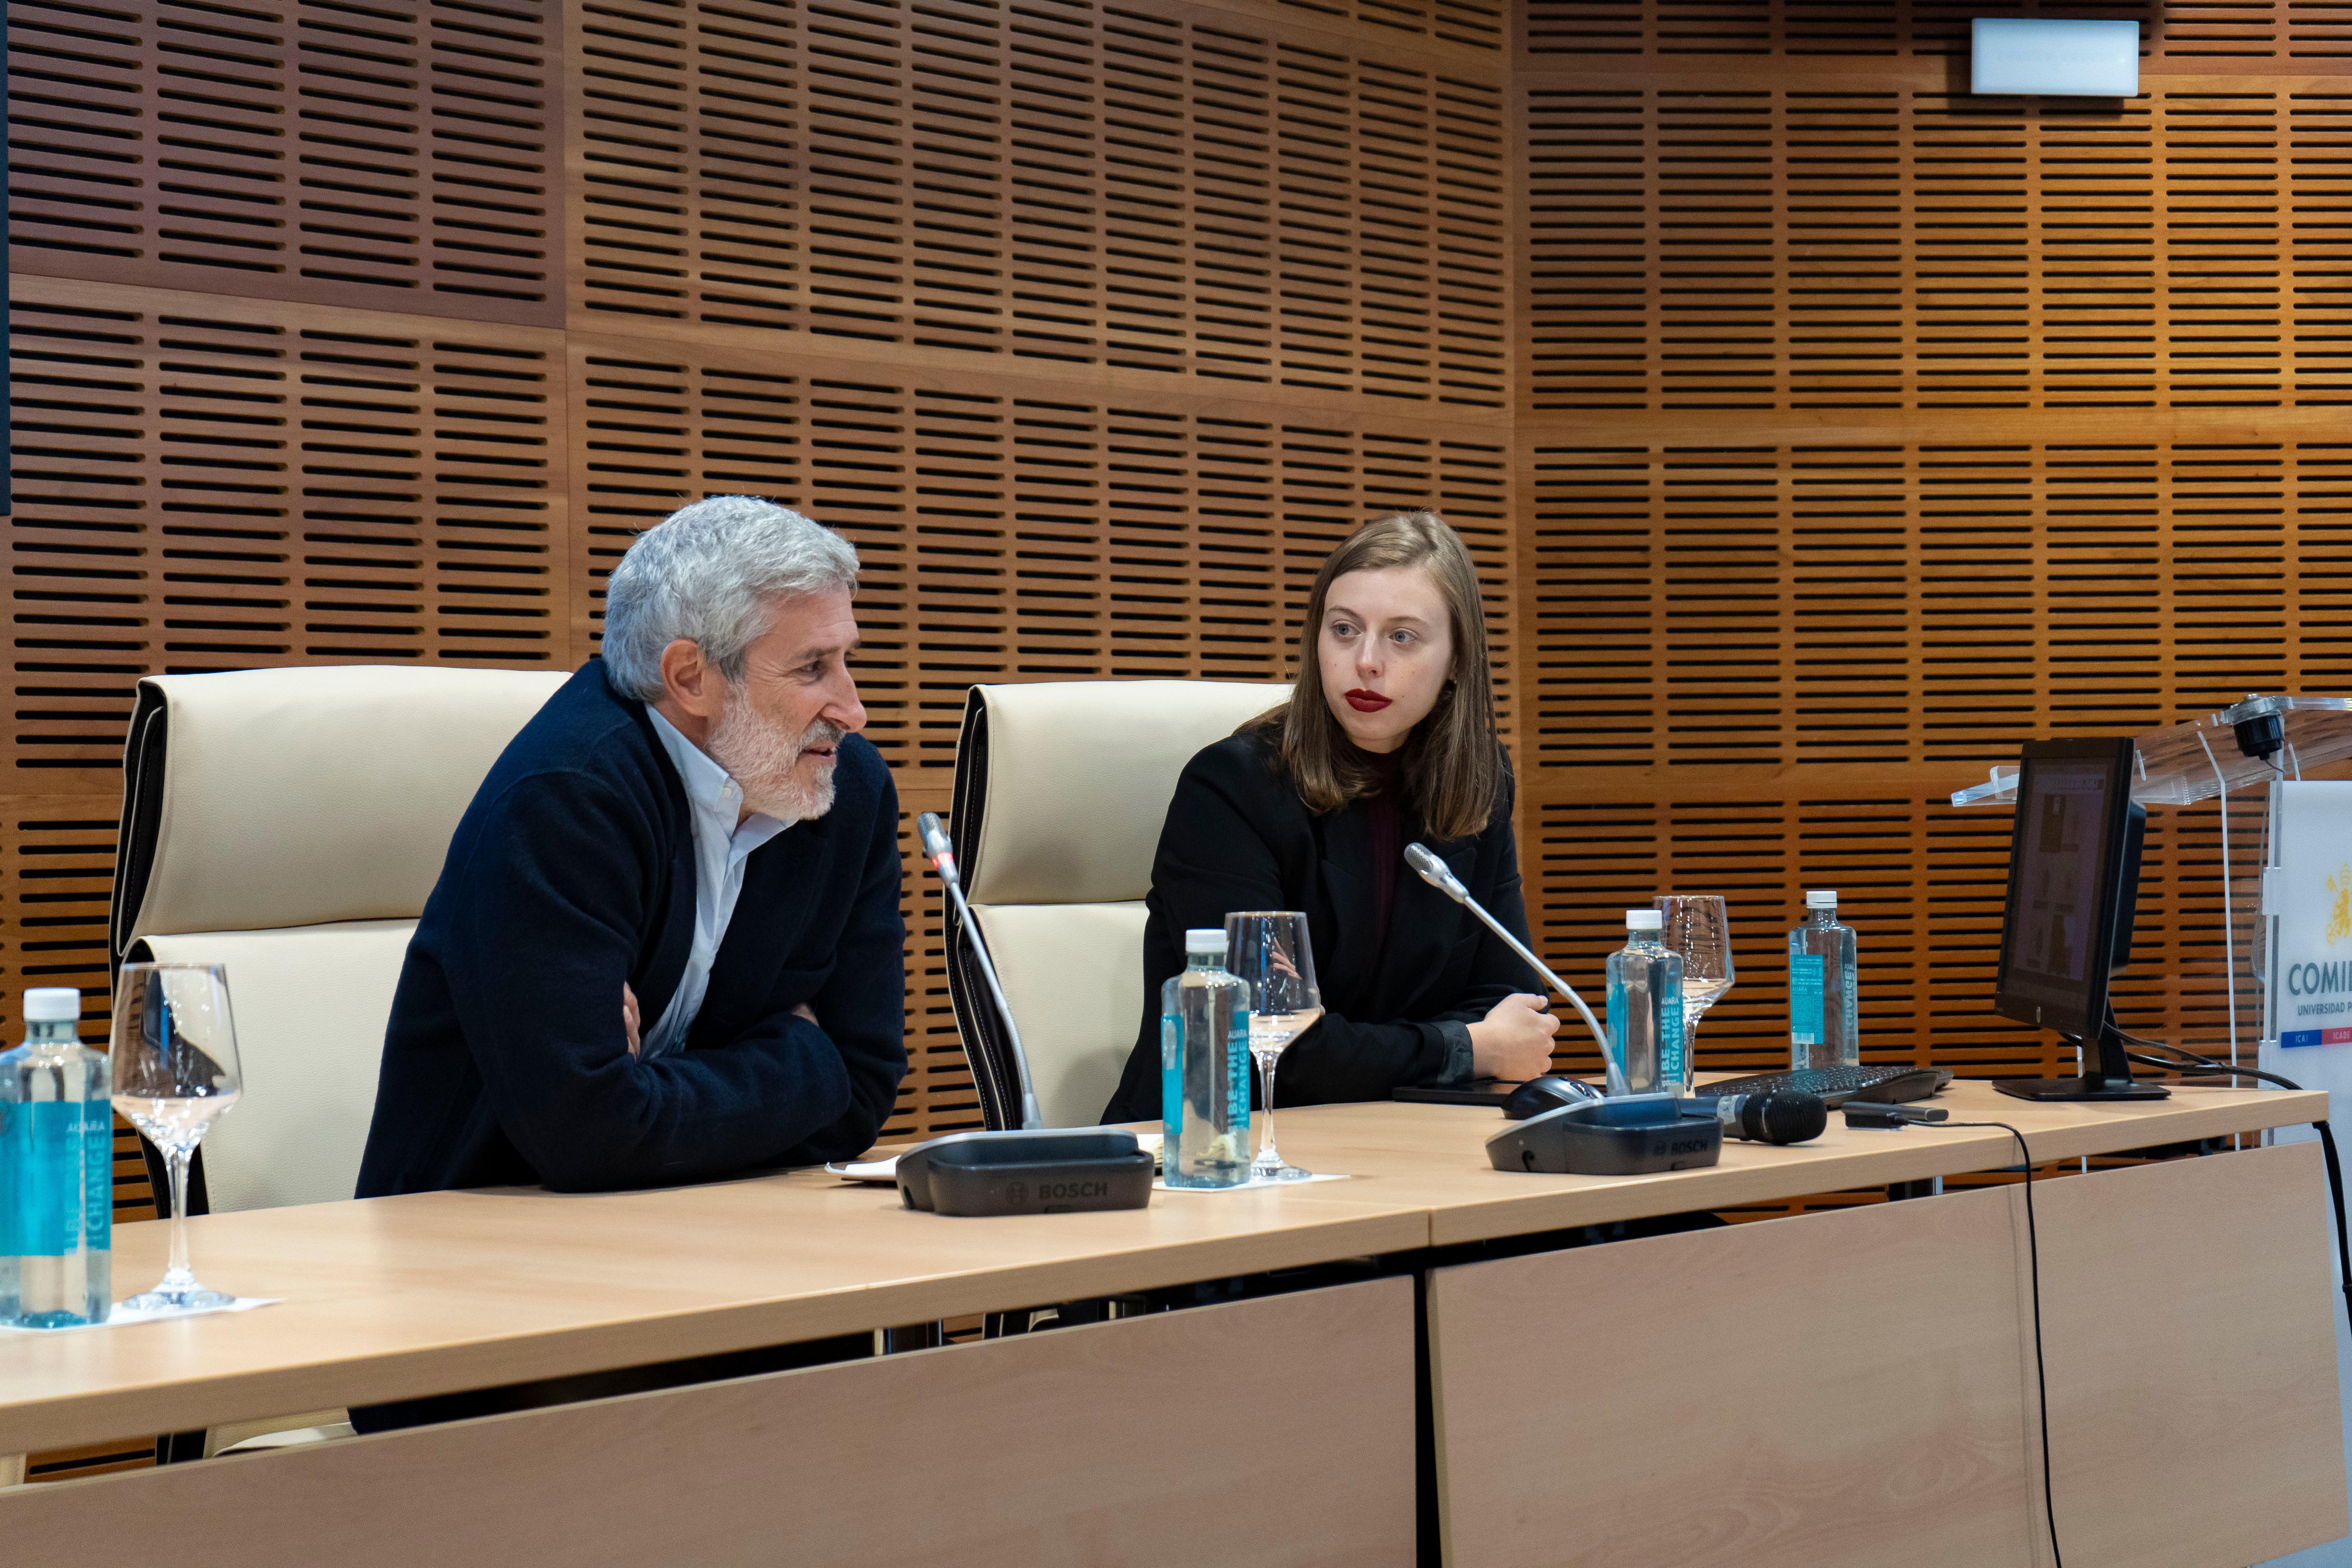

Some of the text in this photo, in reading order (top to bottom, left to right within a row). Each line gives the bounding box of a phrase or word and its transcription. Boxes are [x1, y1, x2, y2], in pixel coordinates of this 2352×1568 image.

[1661, 996, 1679, 1005] AUARA
[2298, 1002, 2345, 1016] UNIVERSIDAD
[1661, 1007, 1671, 1042] THE
[2333, 1031, 2350, 1040] ICADE
[1671, 1007, 1680, 1071] CHANGE
[2295, 1034, 2308, 1043] ICAI
[1227, 1042, 1238, 1081] THE
[1661, 1049, 1670, 1071] BE
[1238, 1040, 1247, 1114] CHANGE
[1227, 1089, 1238, 1115] BE
[1671, 1140, 1708, 1153] BOSCH
[86, 1136, 106, 1231] CHANGE
[1039, 1181, 1107, 1199] BOSCH
